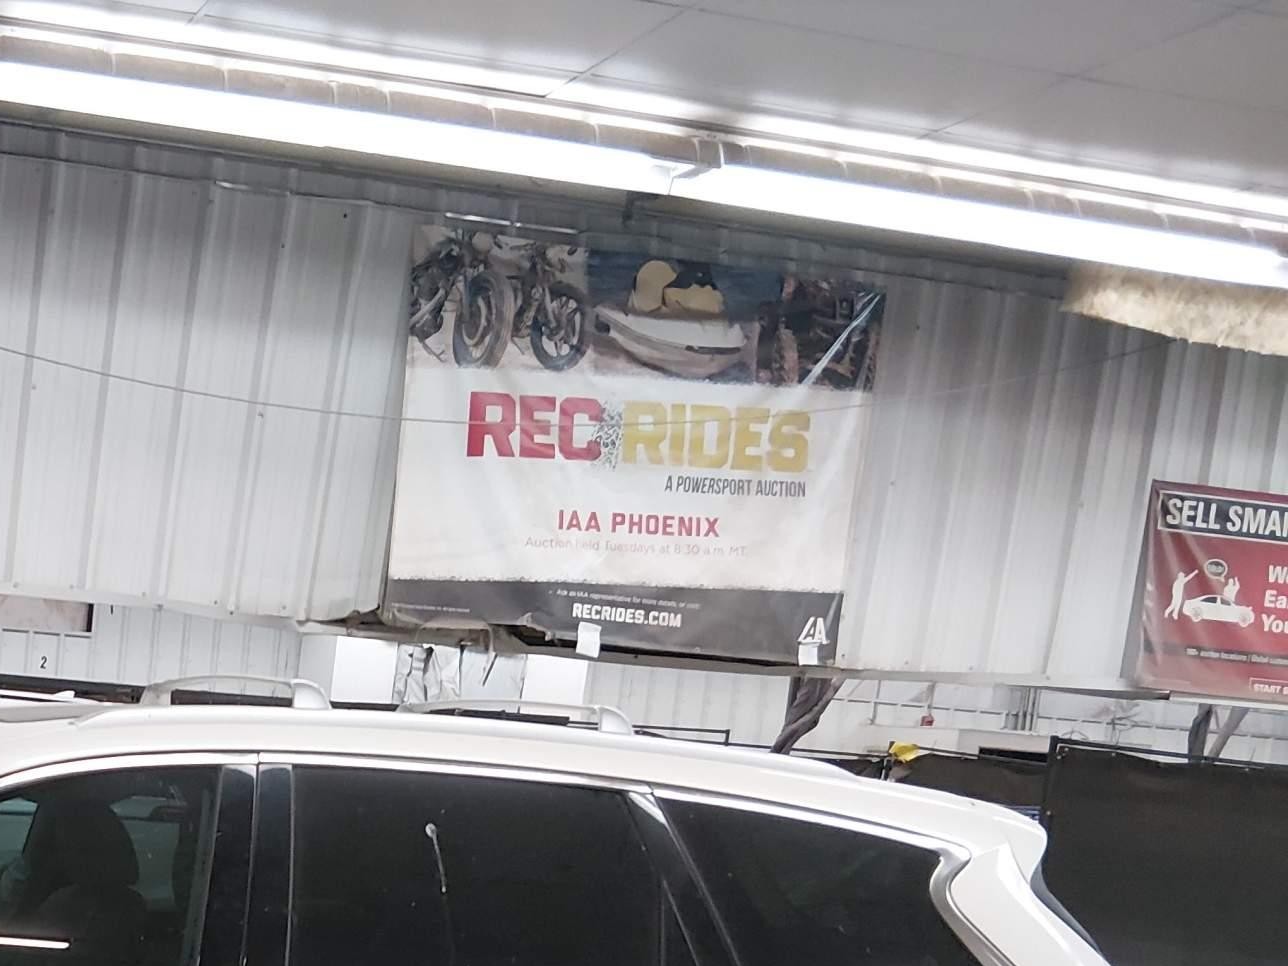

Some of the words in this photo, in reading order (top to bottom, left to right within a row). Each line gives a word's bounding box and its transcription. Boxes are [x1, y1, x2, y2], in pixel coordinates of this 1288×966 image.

[467, 391, 602, 461] REC
[622, 400, 811, 473] RIDES
[665, 475, 674, 492] A
[677, 477, 752, 496] POWERSPORT
[756, 479, 807, 498] AUCTION
[558, 509, 601, 532] IAA
[611, 512, 720, 538] PHOENIX
[1166, 498, 1220, 530] SELL
[525, 536, 572, 549] Auction
[673, 544, 701, 555] 830
[1269, 565, 1288, 584] W
[1264, 590, 1288, 609] Ea
[572, 603, 682, 627] RECRIDES.COM
[40, 655, 48, 669] 2
